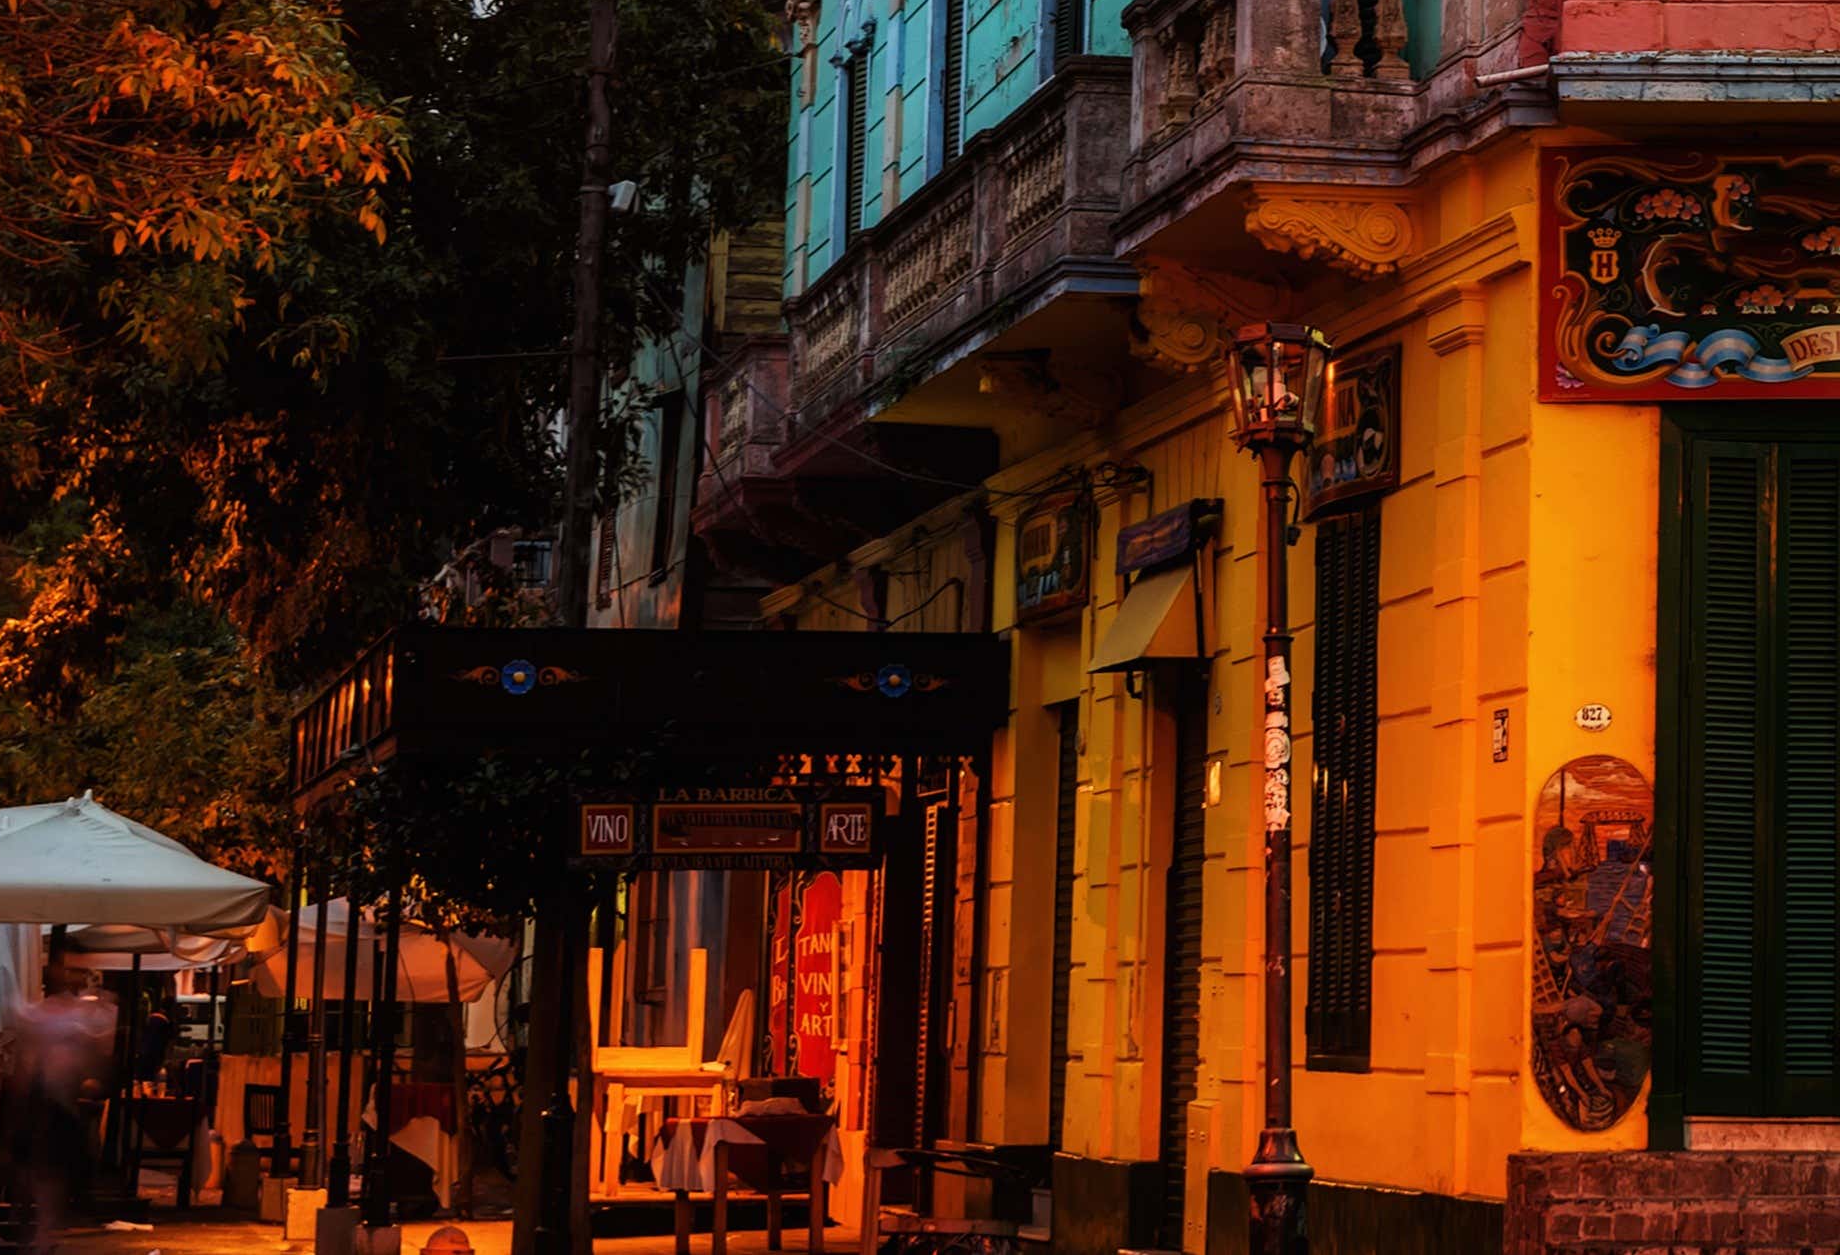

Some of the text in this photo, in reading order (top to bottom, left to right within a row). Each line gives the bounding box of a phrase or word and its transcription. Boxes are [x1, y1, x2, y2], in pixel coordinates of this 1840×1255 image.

[1595, 252, 1613, 278] H
[1582, 707, 1602, 721] 827
[659, 788, 797, 802] LA BARRICA
[587, 814, 628, 843] VINO
[824, 813, 868, 846] ARTE
[775, 935, 789, 965] L
[799, 932, 832, 957] TAN
[799, 972, 832, 996] VIN
[799, 1013, 832, 1037] ART
